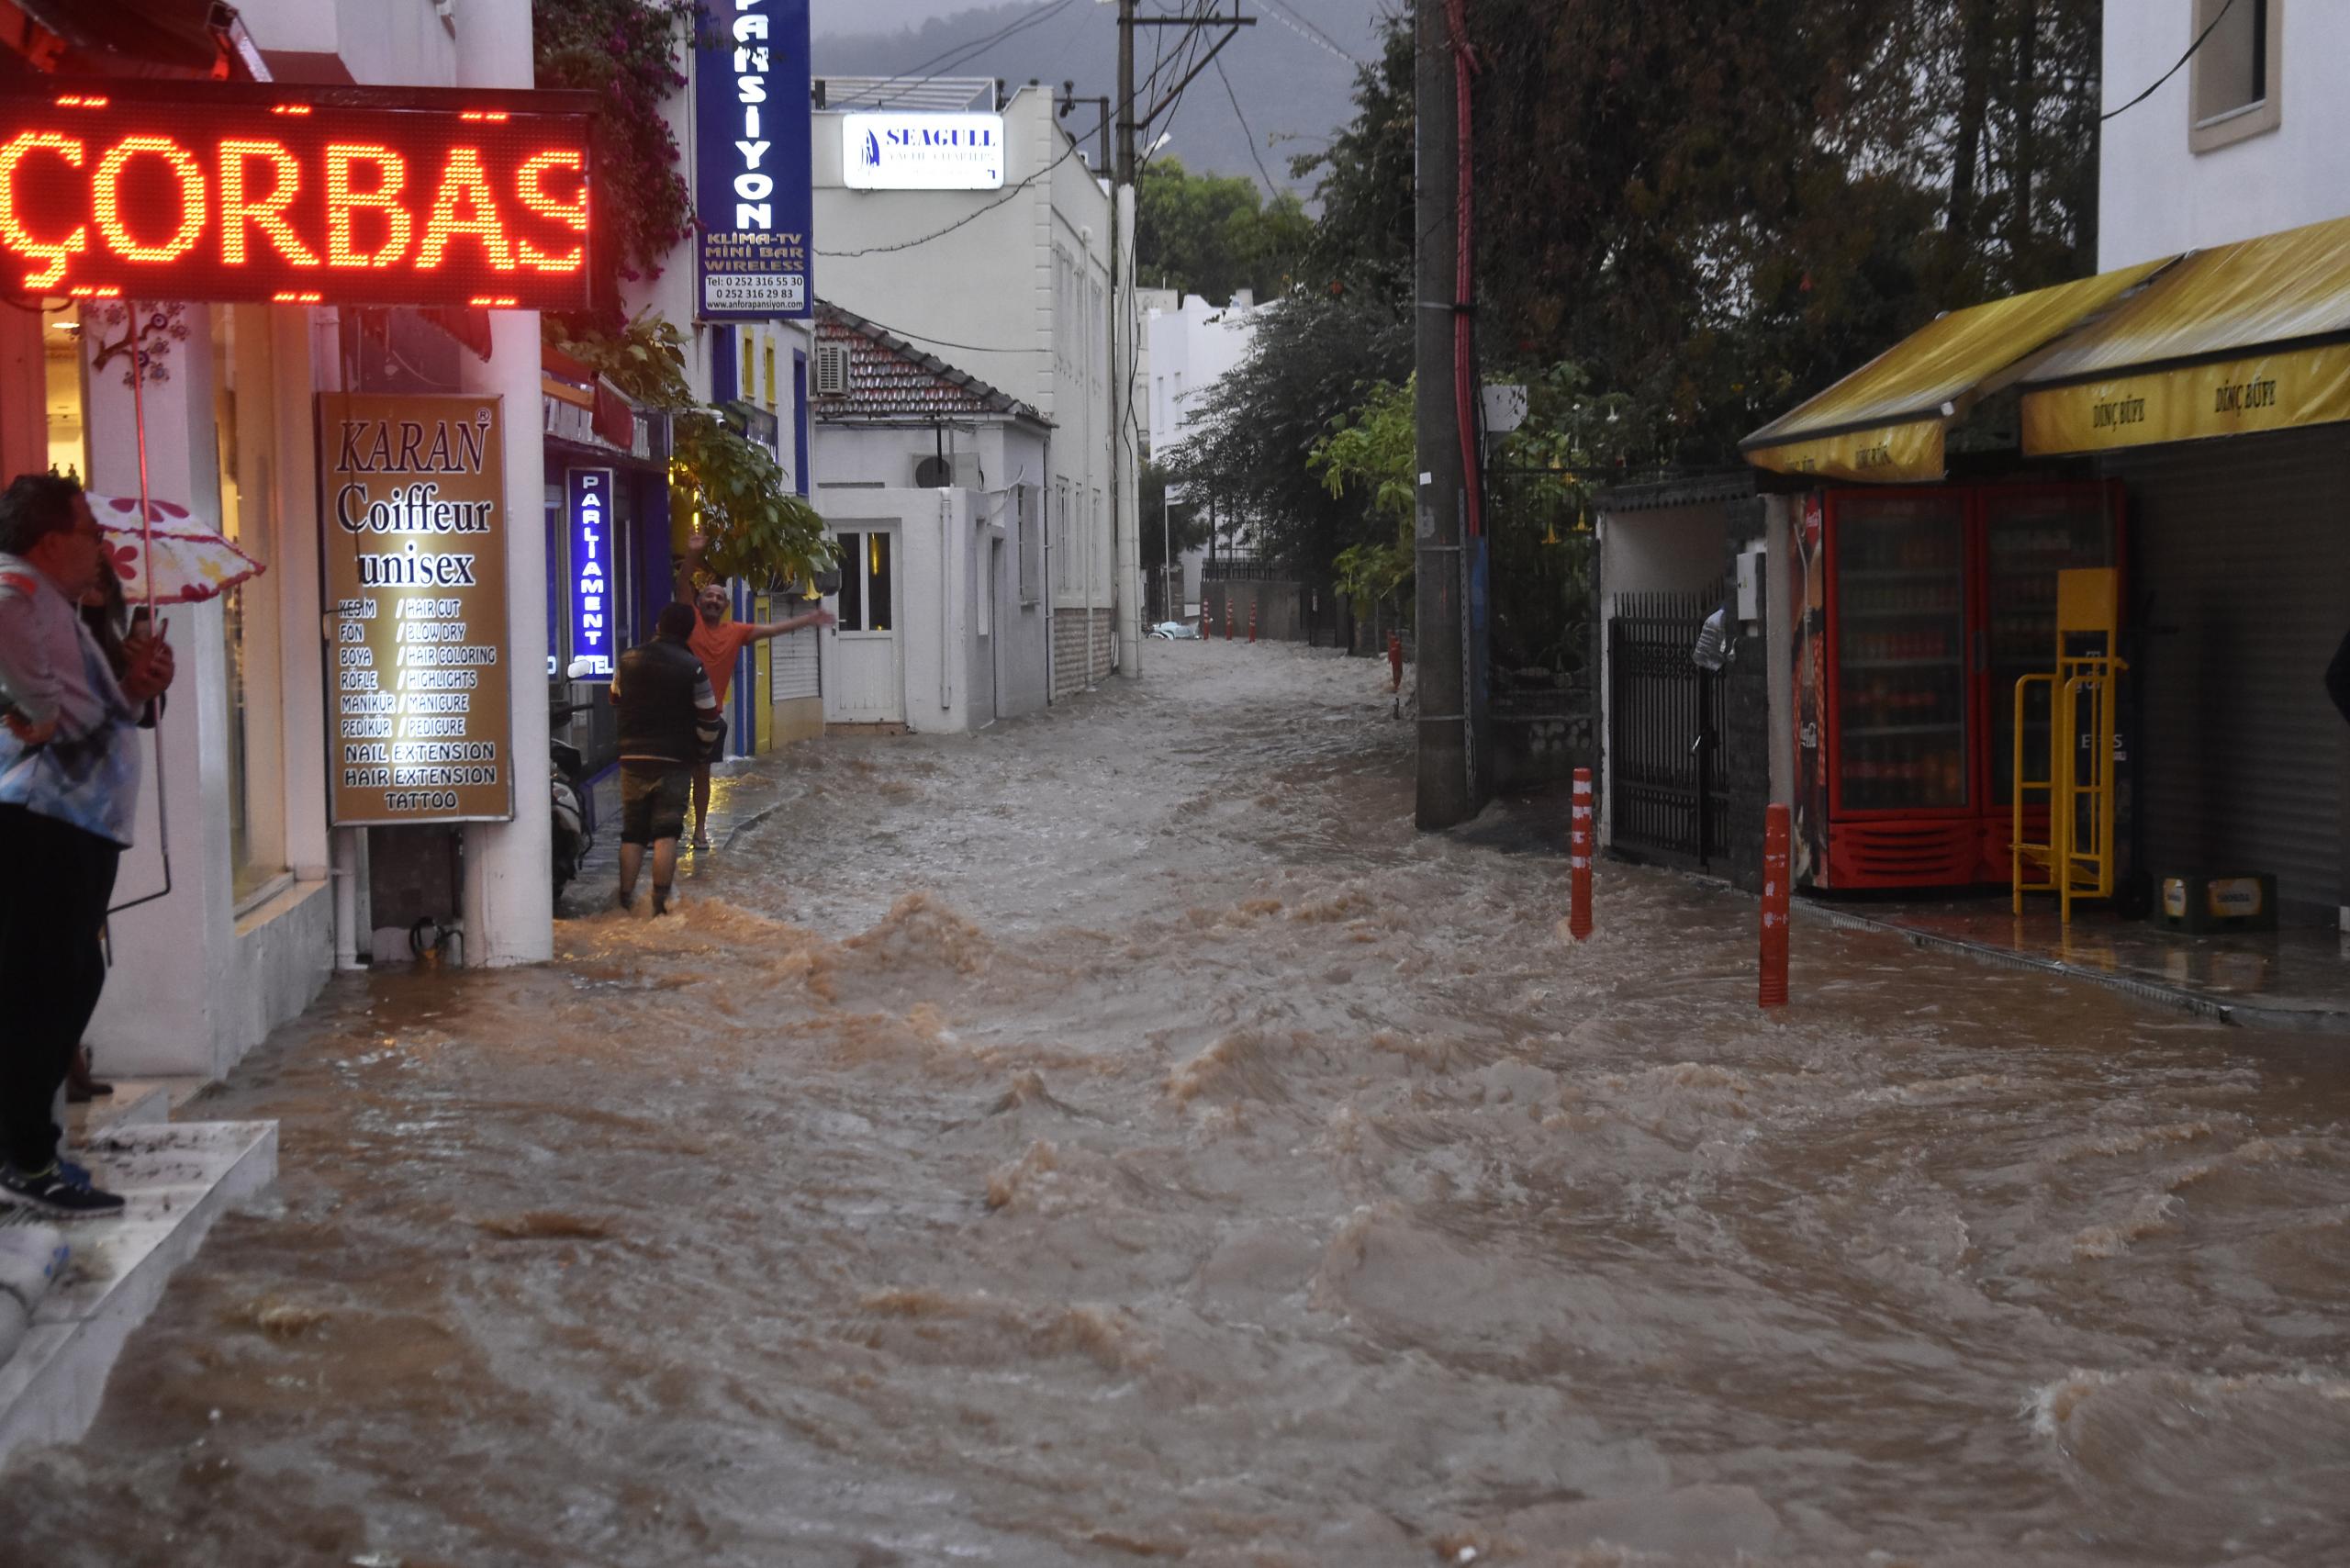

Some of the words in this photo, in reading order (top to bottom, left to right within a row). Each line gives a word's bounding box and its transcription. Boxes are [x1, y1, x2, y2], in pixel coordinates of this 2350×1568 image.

[887, 129, 996, 146] SEAGULL
[0, 130, 588, 288] ÇORBAS
[759, 247, 804, 258] BAR
[704, 261, 804, 272] WIRELESS
[707, 277, 723, 286] Tel:
[726, 277, 733, 286] 0
[735, 277, 753, 286] 252
[756, 277, 774, 286] 316
[777, 277, 788, 286] 55
[791, 277, 803, 286] 30
[716, 289, 722, 298] 0
[725, 289, 743, 298] 252
[746, 289, 764, 298] 316
[767, 289, 778, 298] 29
[781, 289, 793, 298] 83
[707, 300, 803, 311] www.anforapansiyon.com
[336, 420, 491, 474] KARAN
[336, 482, 493, 533] Coiffeur
[356, 540, 476, 588] unisex
[406, 599, 436, 618] HAIR
[437, 599, 461, 618] CUT
[340, 621, 364, 643] FÖN
[407, 623, 441, 642] BLOW
[442, 623, 466, 642] DRY
[340, 647, 373, 666] BOYA
[407, 647, 436, 666] HAIR
[438, 647, 496, 666] COLORING
[340, 668, 378, 690] RÖFLE
[407, 670, 477, 689] HIGHLIGHTS
[341, 691, 396, 714] MANİKÜR
[408, 694, 469, 713] MANICURE
[341, 715, 392, 738] PEDİKÜR
[408, 718, 465, 737] PEDICURE
[345, 743, 389, 763] NAIL
[392, 743, 496, 763] EXTENSION
[345, 768, 390, 788] HAIR
[394, 767, 497, 787] EXTENSION
[385, 791, 458, 811] TATTOO
